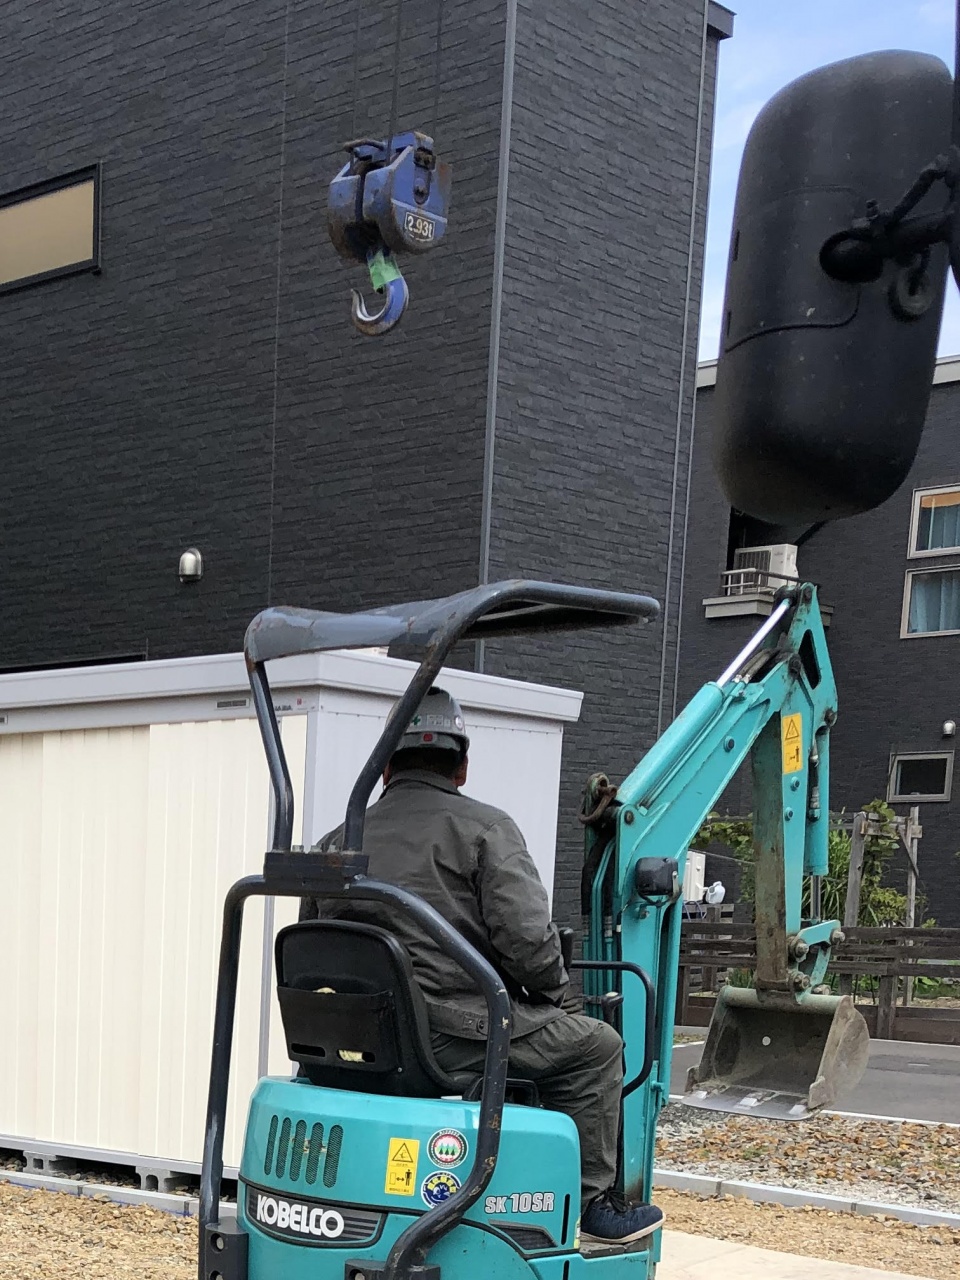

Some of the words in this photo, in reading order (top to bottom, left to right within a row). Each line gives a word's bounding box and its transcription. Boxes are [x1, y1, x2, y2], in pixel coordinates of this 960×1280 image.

[407, 215, 433, 238] 2.93t
[484, 1196, 507, 1214] SK
[509, 1192, 555, 1213] 10SR
[257, 1194, 344, 1238] KOBELCO
